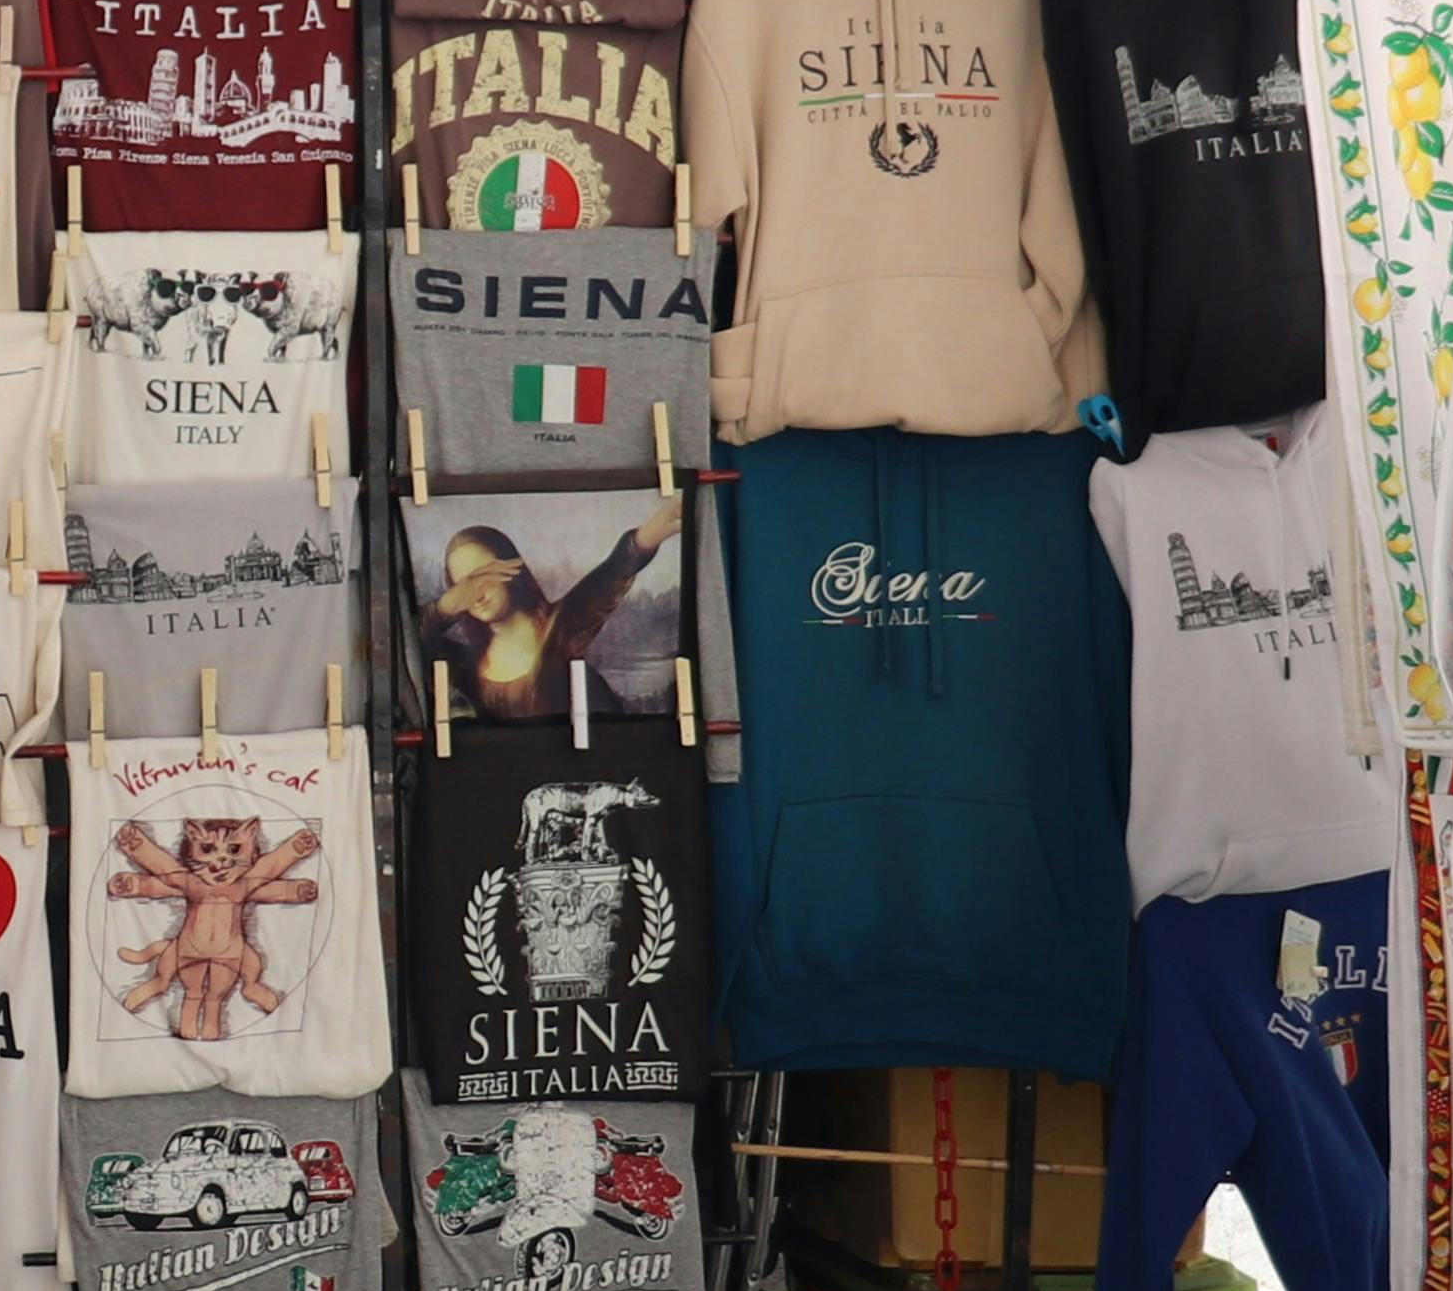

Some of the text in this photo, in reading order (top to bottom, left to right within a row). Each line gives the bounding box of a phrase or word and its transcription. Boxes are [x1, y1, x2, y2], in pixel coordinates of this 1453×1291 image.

[848, 16, 945, 37] Itia
[391, 29, 677, 175] ITALIA
[900, 102, 922, 116] EL
[936, 103, 993, 119] PALIO
[82, 146, 113, 161] Pisa
[172, 152, 210, 166] Siena
[216, 152, 267, 166] Venezia
[271, 151, 295, 164] San
[1194, 129, 1304, 162] ITALIA
[414, 267, 710, 326] SIENA
[144, 379, 282, 415] SIENA
[175, 425, 244, 445] ITALY
[533, 432, 577, 443] ITALIA
[146, 606, 273, 636] ITALIA
[266, 768, 321, 794] cat
[464, 1000, 671, 1066] SIENA
[509, 1064, 625, 1098] ITALIA
[224, 1205, 344, 1267] Design
